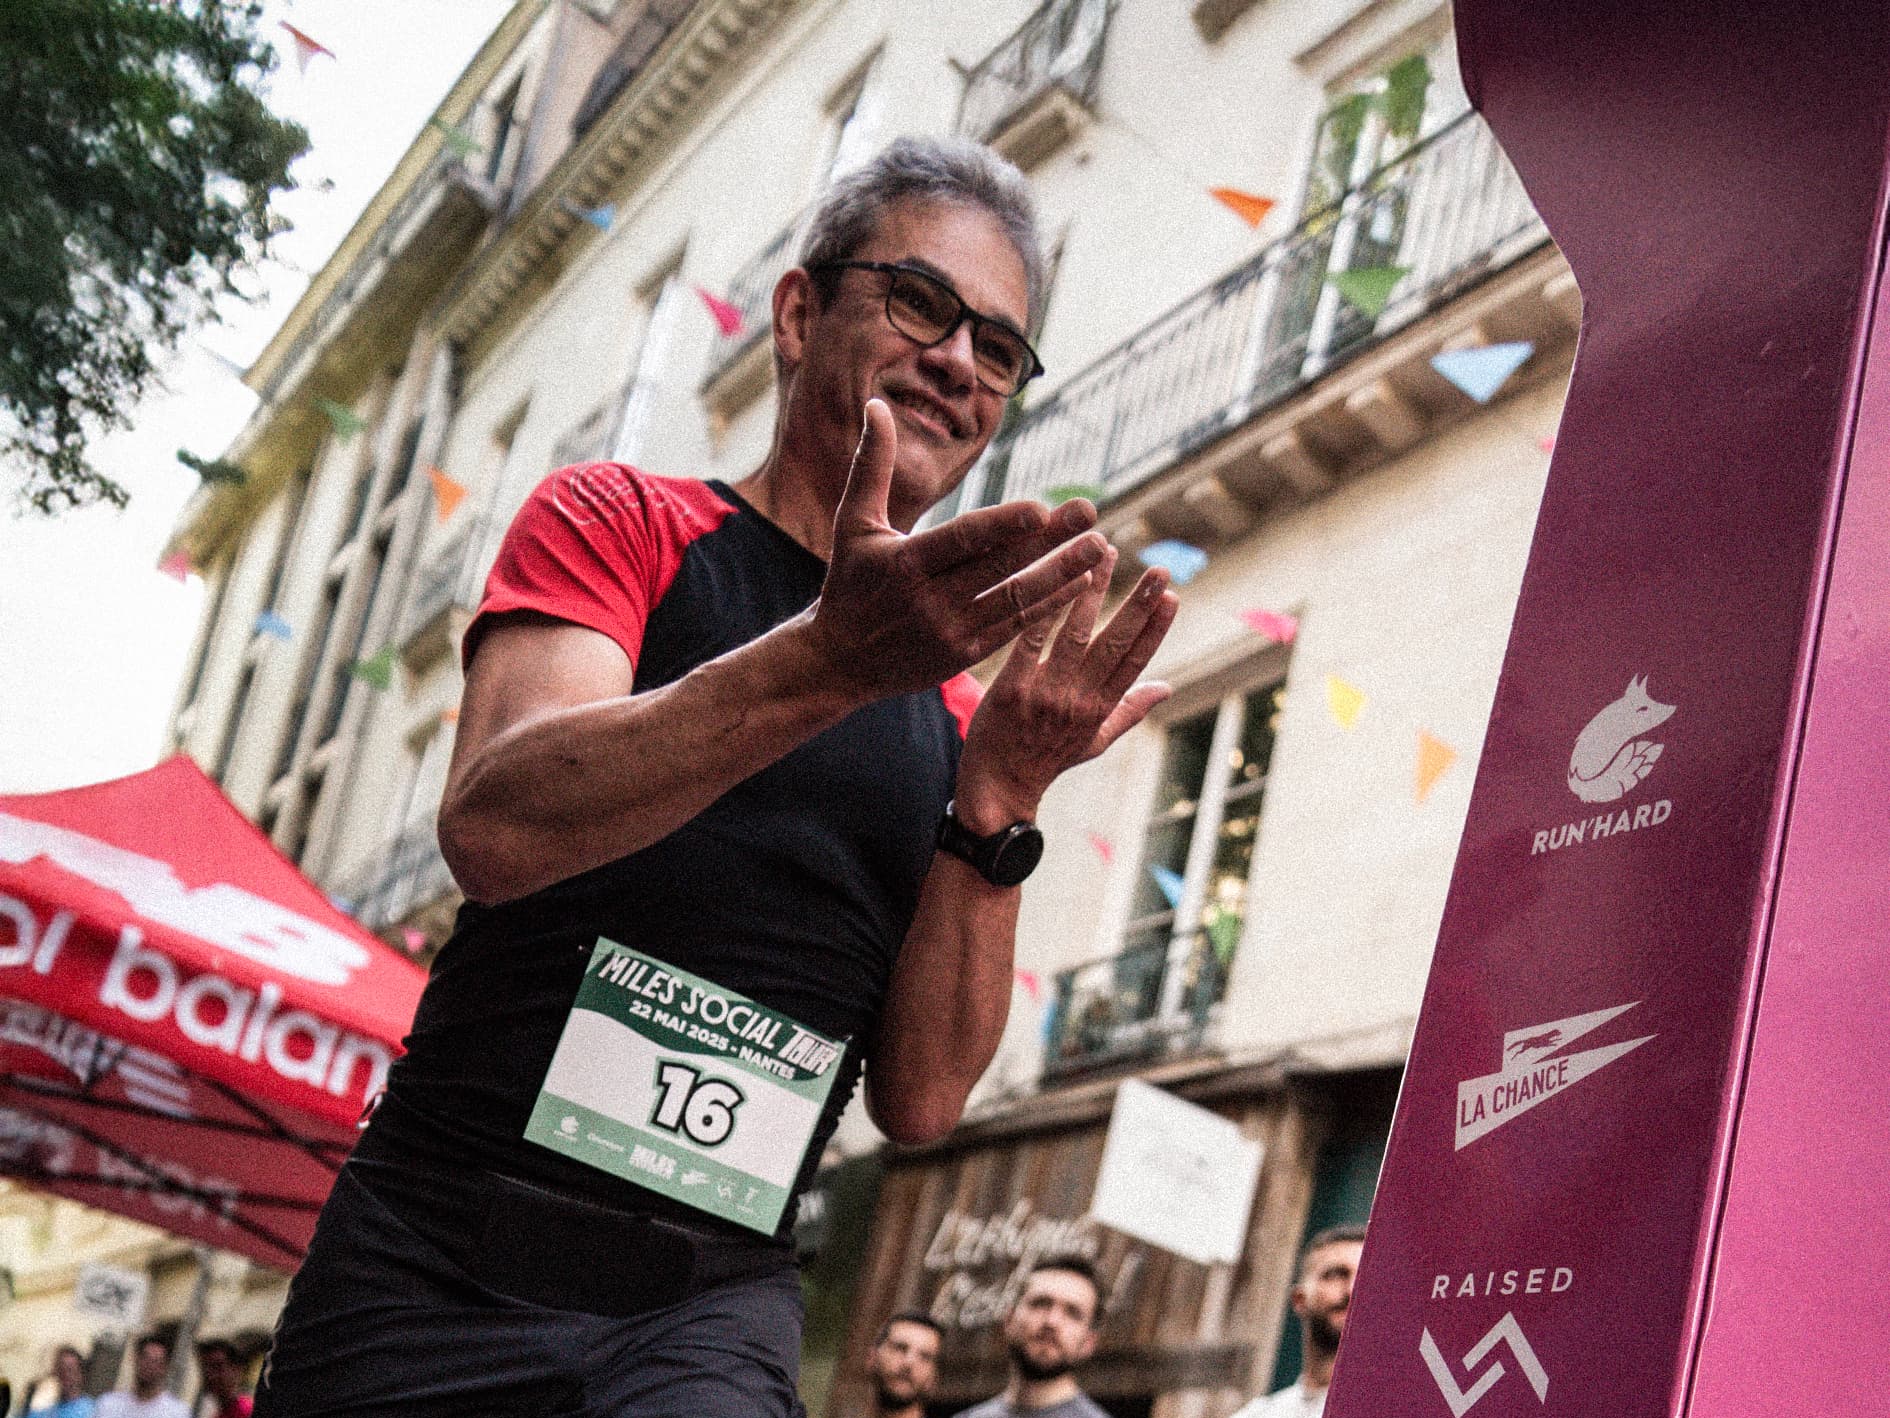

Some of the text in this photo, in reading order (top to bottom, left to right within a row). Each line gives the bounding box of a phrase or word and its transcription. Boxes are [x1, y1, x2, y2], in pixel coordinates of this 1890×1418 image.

[598, 951, 838, 1076] MILES SOCIAL TOUR
[628, 1000, 652, 1020] 22
[652, 1009, 688, 1034] MAI
[686, 1022, 728, 1052] 2025
[738, 1045, 797, 1081] NANTES
[650, 1060, 745, 1147] 16
[1460, 1057, 1569, 1128] LA CHANCE
[1431, 1266, 1575, 1300] RAISED
